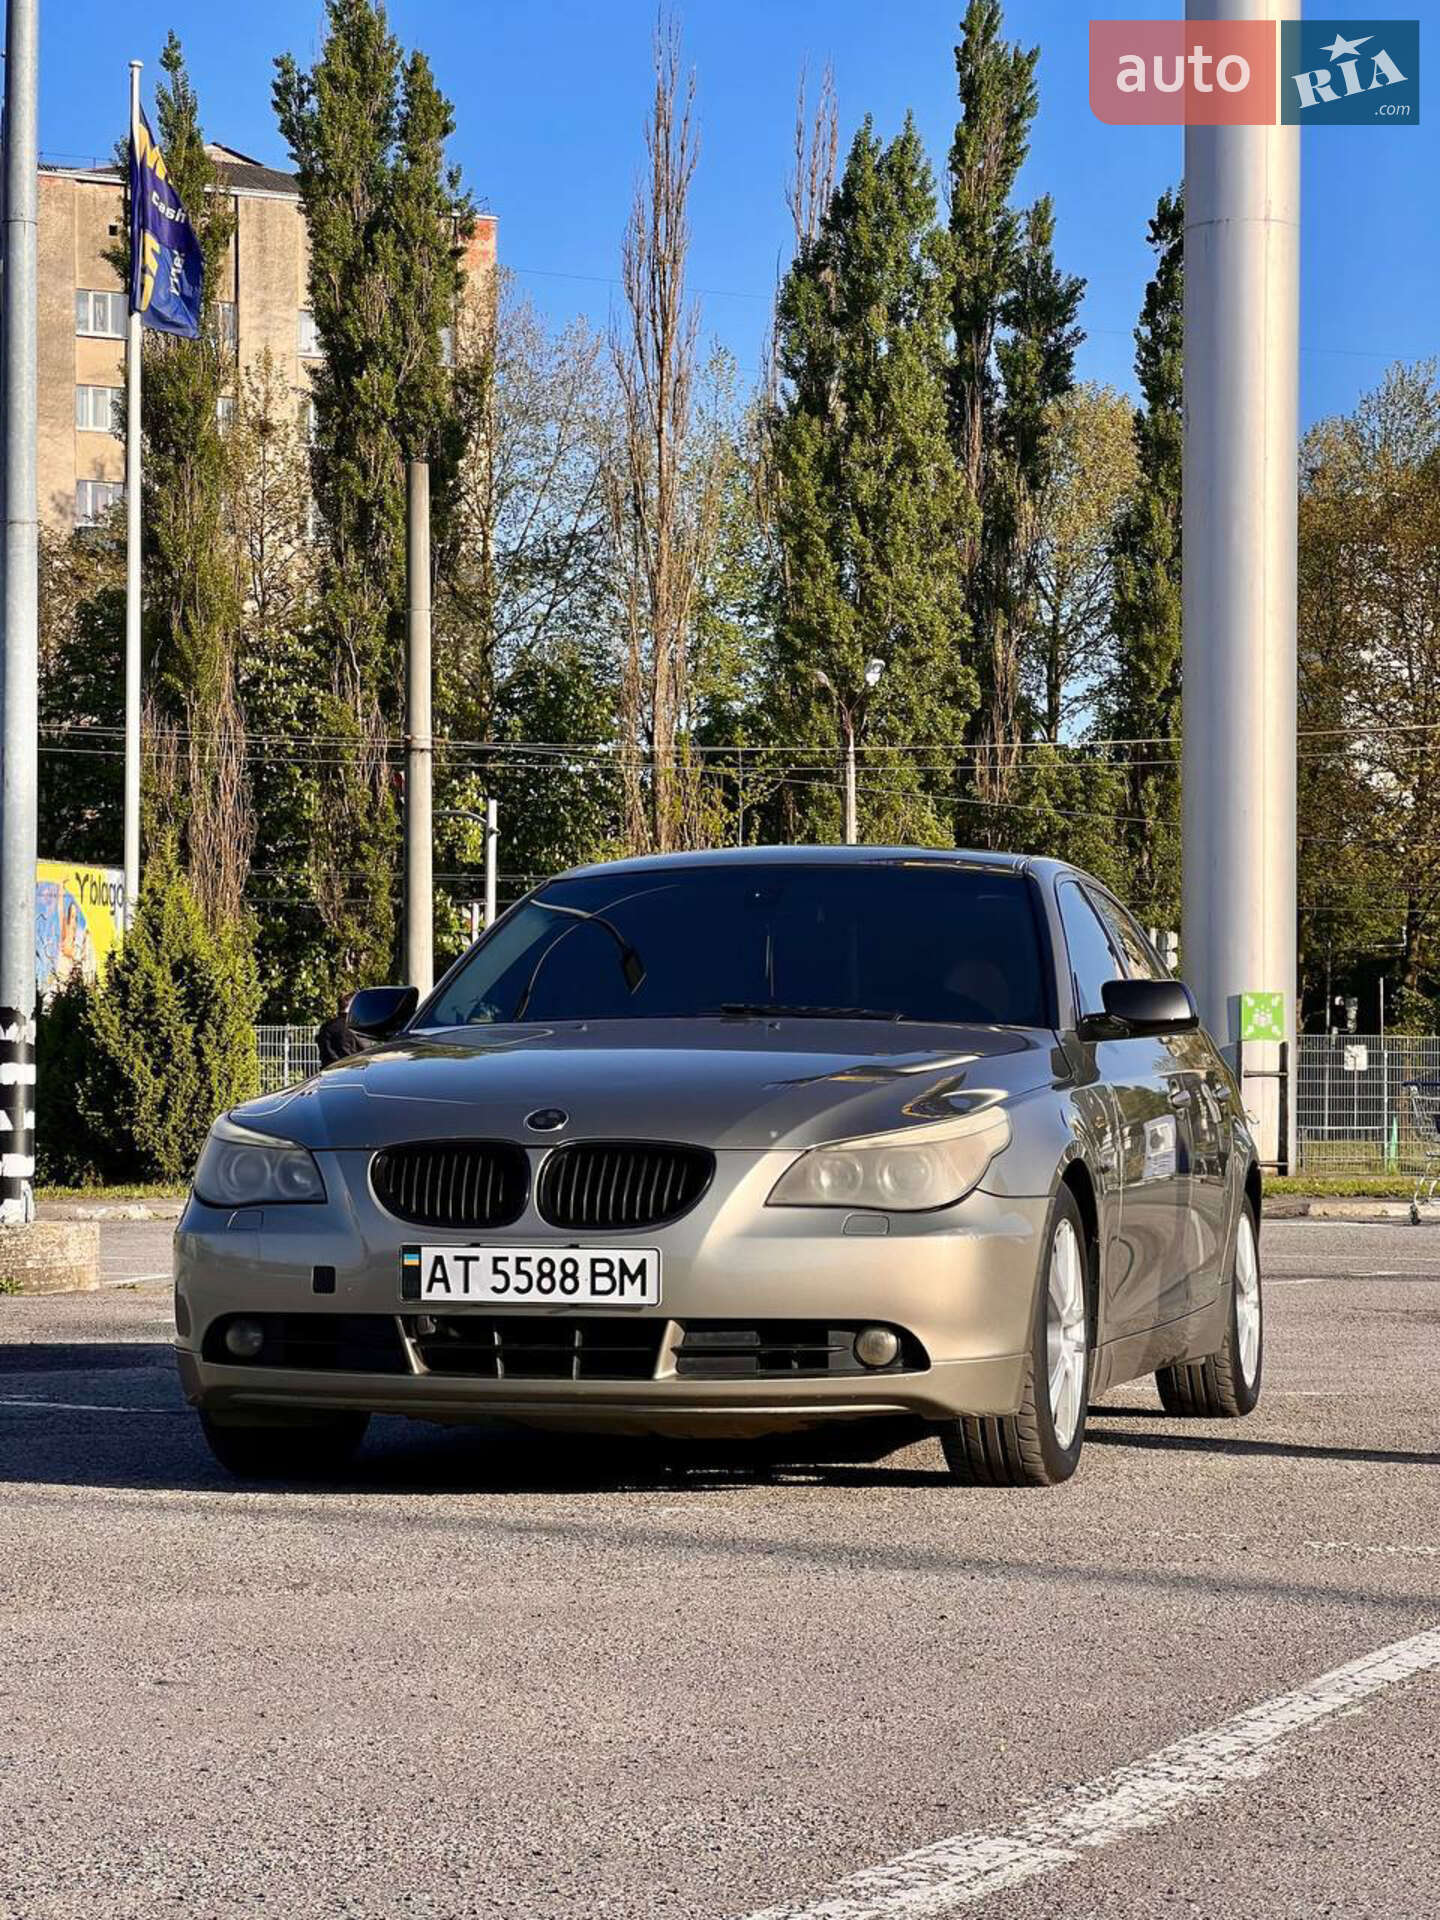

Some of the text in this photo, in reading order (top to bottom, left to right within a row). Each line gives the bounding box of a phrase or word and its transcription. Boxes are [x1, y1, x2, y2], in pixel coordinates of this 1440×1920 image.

[151, 191, 187, 223] Cash
[426, 1255, 647, 1297] AT 5588 BM
